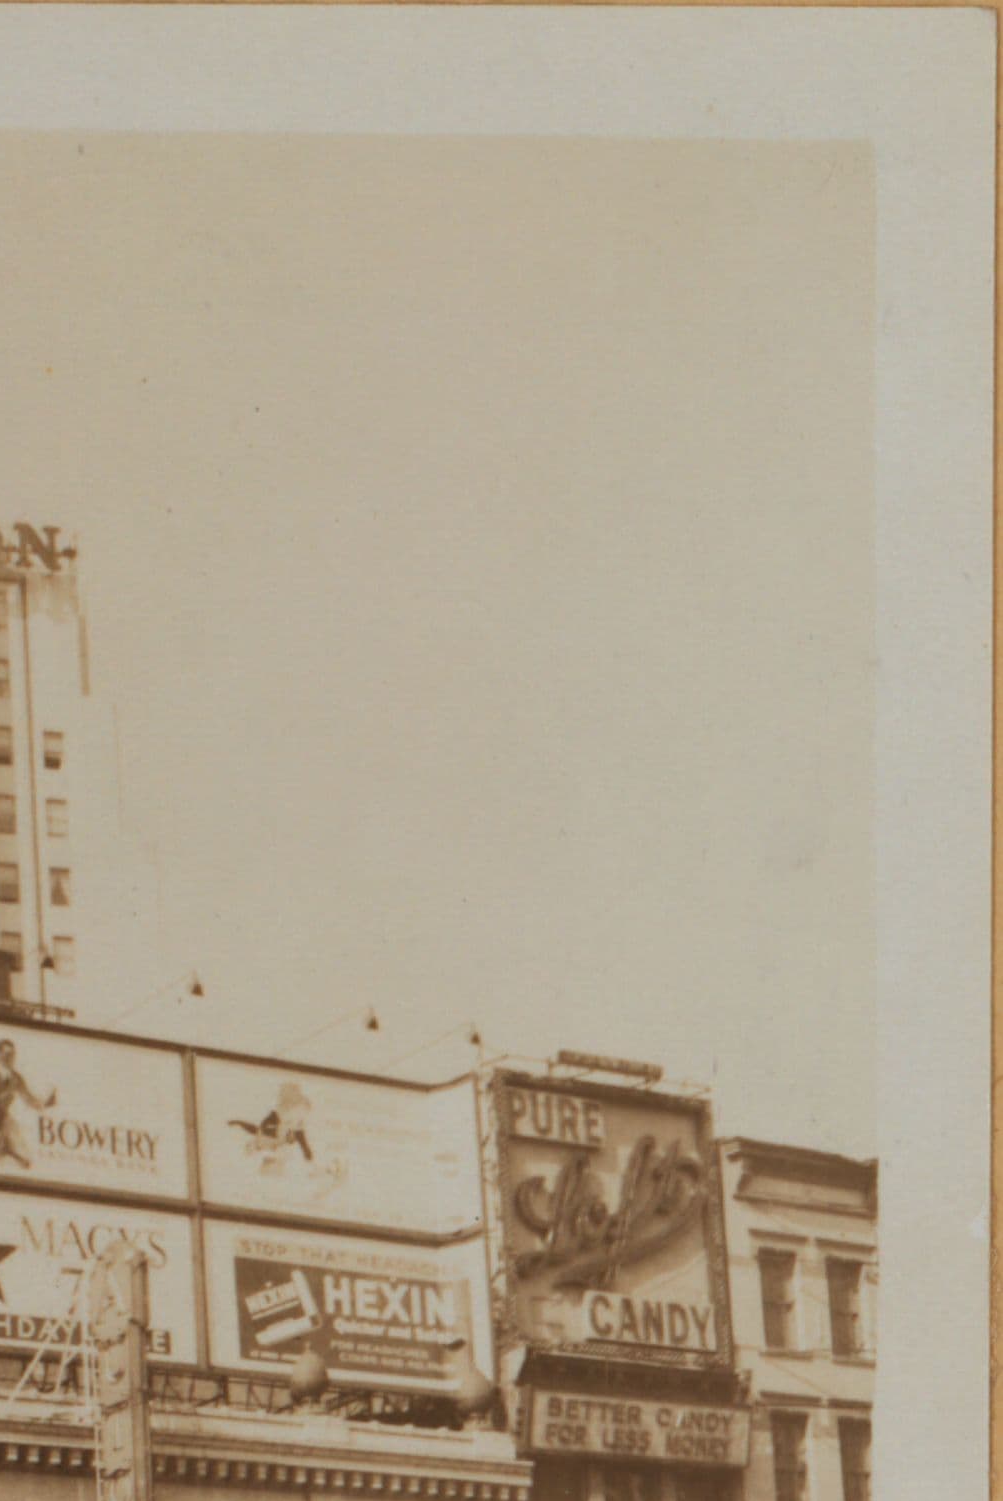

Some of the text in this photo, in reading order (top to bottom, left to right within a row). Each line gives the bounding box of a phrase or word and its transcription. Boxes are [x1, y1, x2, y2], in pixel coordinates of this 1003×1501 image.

[38, 1116, 159, 1162] BOWERY
[510, 1089, 604, 1144] PURE
[239, 1239, 288, 1257] STOP
[300, 1246, 347, 1264] THAT
[323, 1274, 455, 1327] HEXIN
[588, 1294, 715, 1352] CANDY
[549, 1397, 641, 1426] BETTER
[655, 1407, 734, 1434] CANDY
[545, 1422, 587, 1447] FOR
[601, 1427, 651, 1454] LESS
[664, 1432, 733, 1460] MONEY
